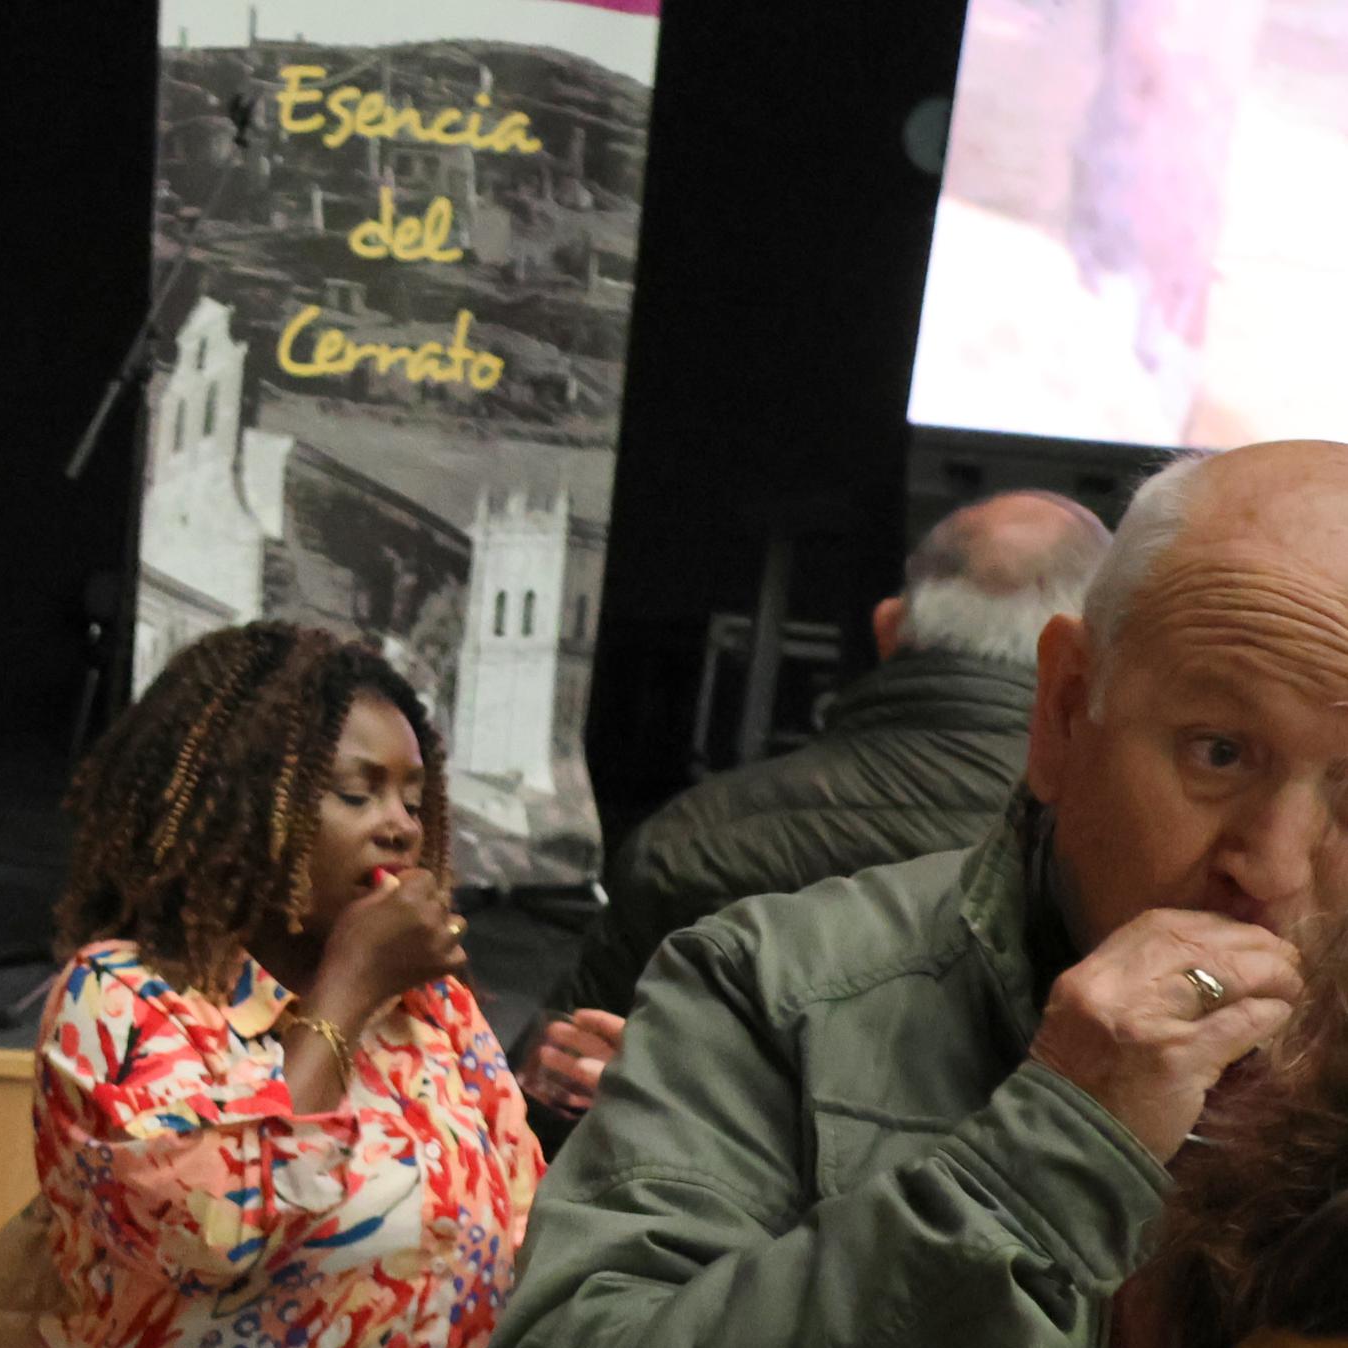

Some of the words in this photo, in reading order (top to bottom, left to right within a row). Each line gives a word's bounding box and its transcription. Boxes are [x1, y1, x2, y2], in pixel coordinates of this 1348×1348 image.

[276, 65, 543, 154] Esencia
[348, 185, 463, 262] del
[276, 305, 506, 390] Cerrato
